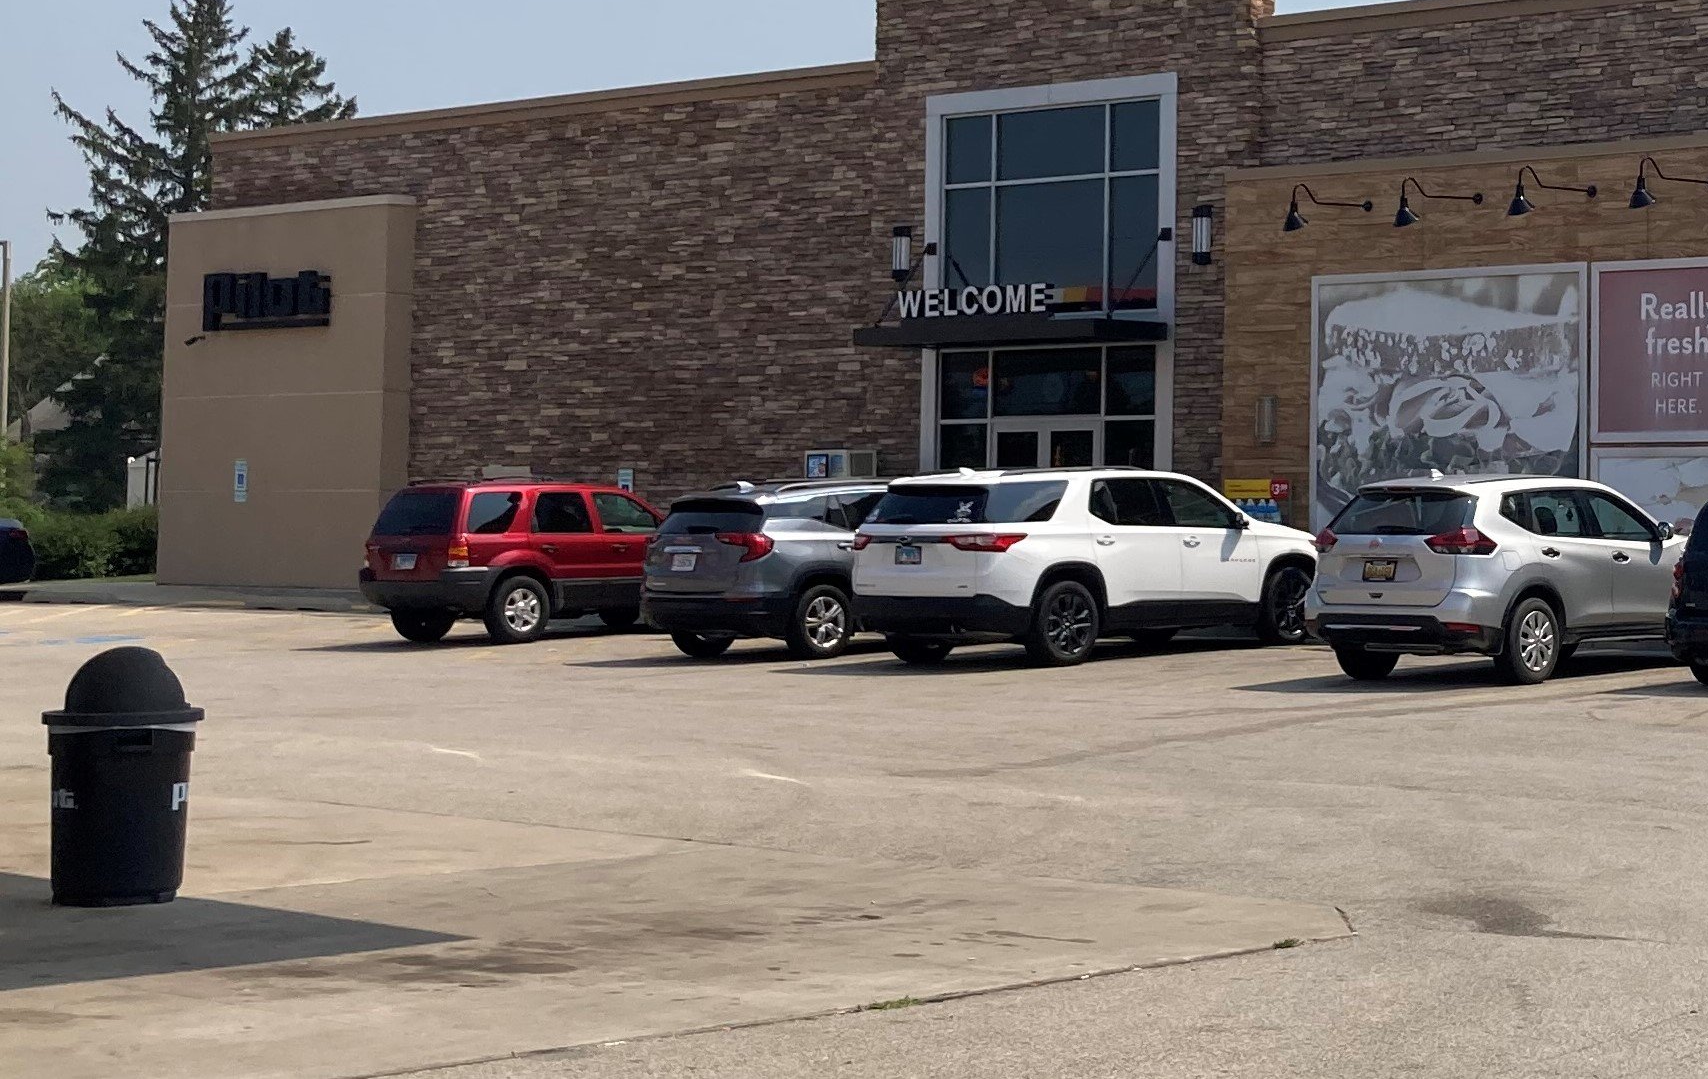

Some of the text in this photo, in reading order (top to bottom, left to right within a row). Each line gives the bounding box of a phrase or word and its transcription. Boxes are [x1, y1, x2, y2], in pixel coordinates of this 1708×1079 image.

[897, 282, 1047, 319] WELCOME
[1651, 371, 1704, 389] RIGHT
[1655, 398, 1702, 414] HERE.
